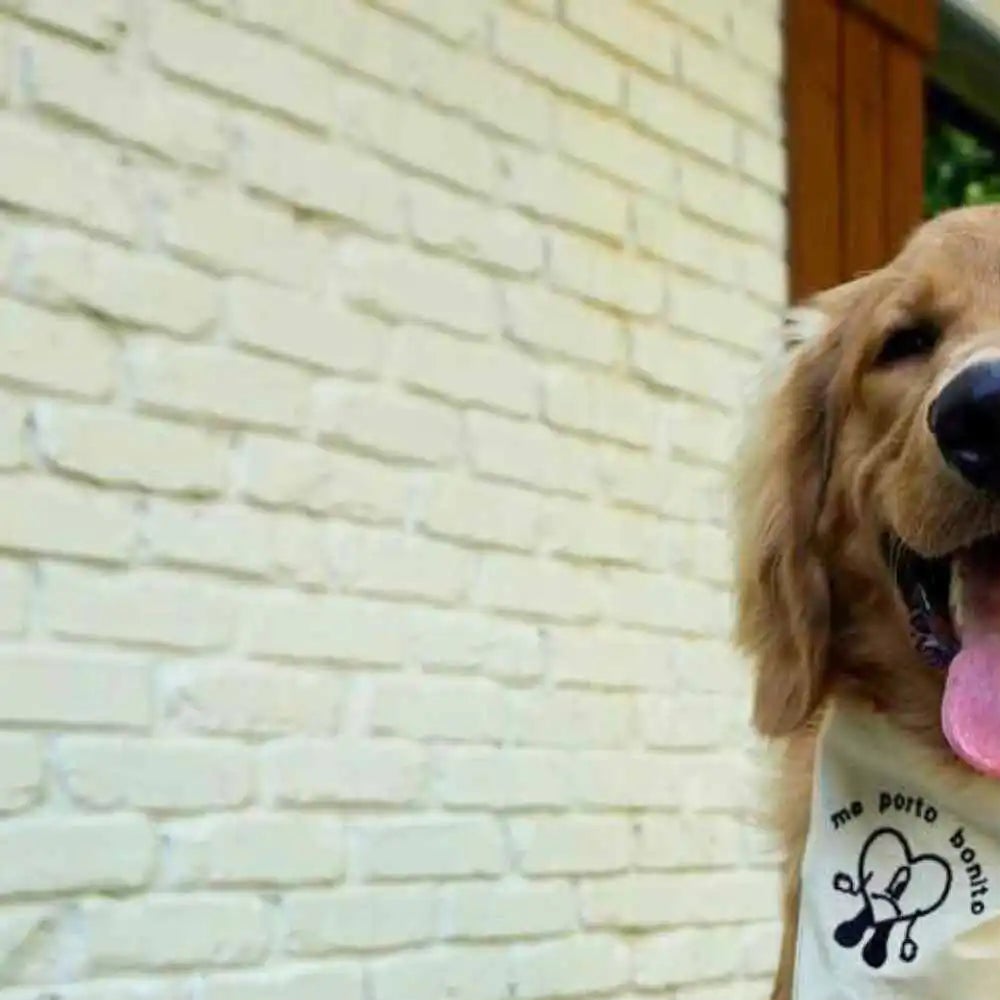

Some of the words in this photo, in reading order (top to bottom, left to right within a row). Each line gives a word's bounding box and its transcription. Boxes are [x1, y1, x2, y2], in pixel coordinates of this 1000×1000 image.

[830, 800, 863, 830] me
[878, 791, 939, 824] porto
[949, 826, 989, 915] bonito
